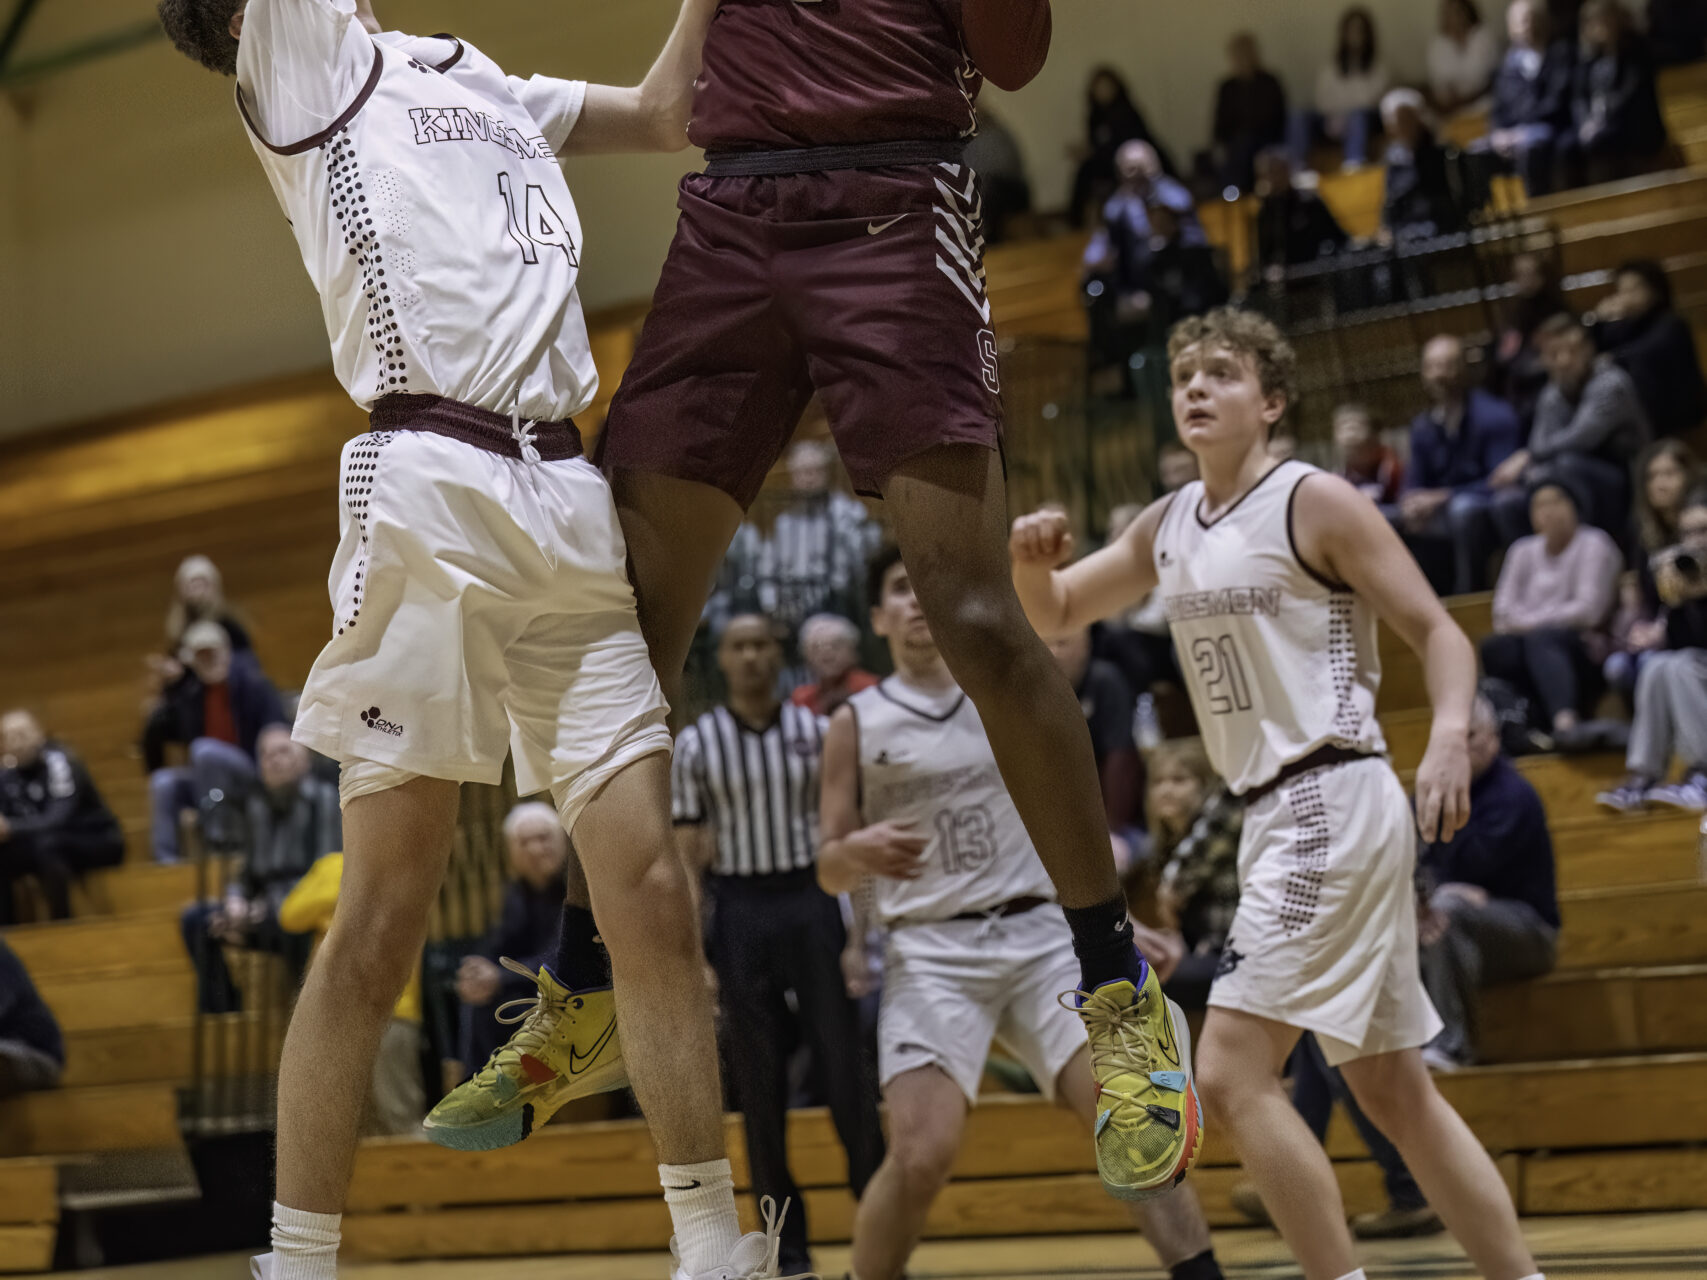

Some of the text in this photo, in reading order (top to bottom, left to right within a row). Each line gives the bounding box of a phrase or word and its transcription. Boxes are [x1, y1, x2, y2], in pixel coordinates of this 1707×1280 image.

[497, 171, 579, 268] 14
[976, 328, 1000, 395] S
[1192, 634, 1252, 715] 21
[376, 719, 404, 733] DNA
[934, 803, 999, 876] 13
